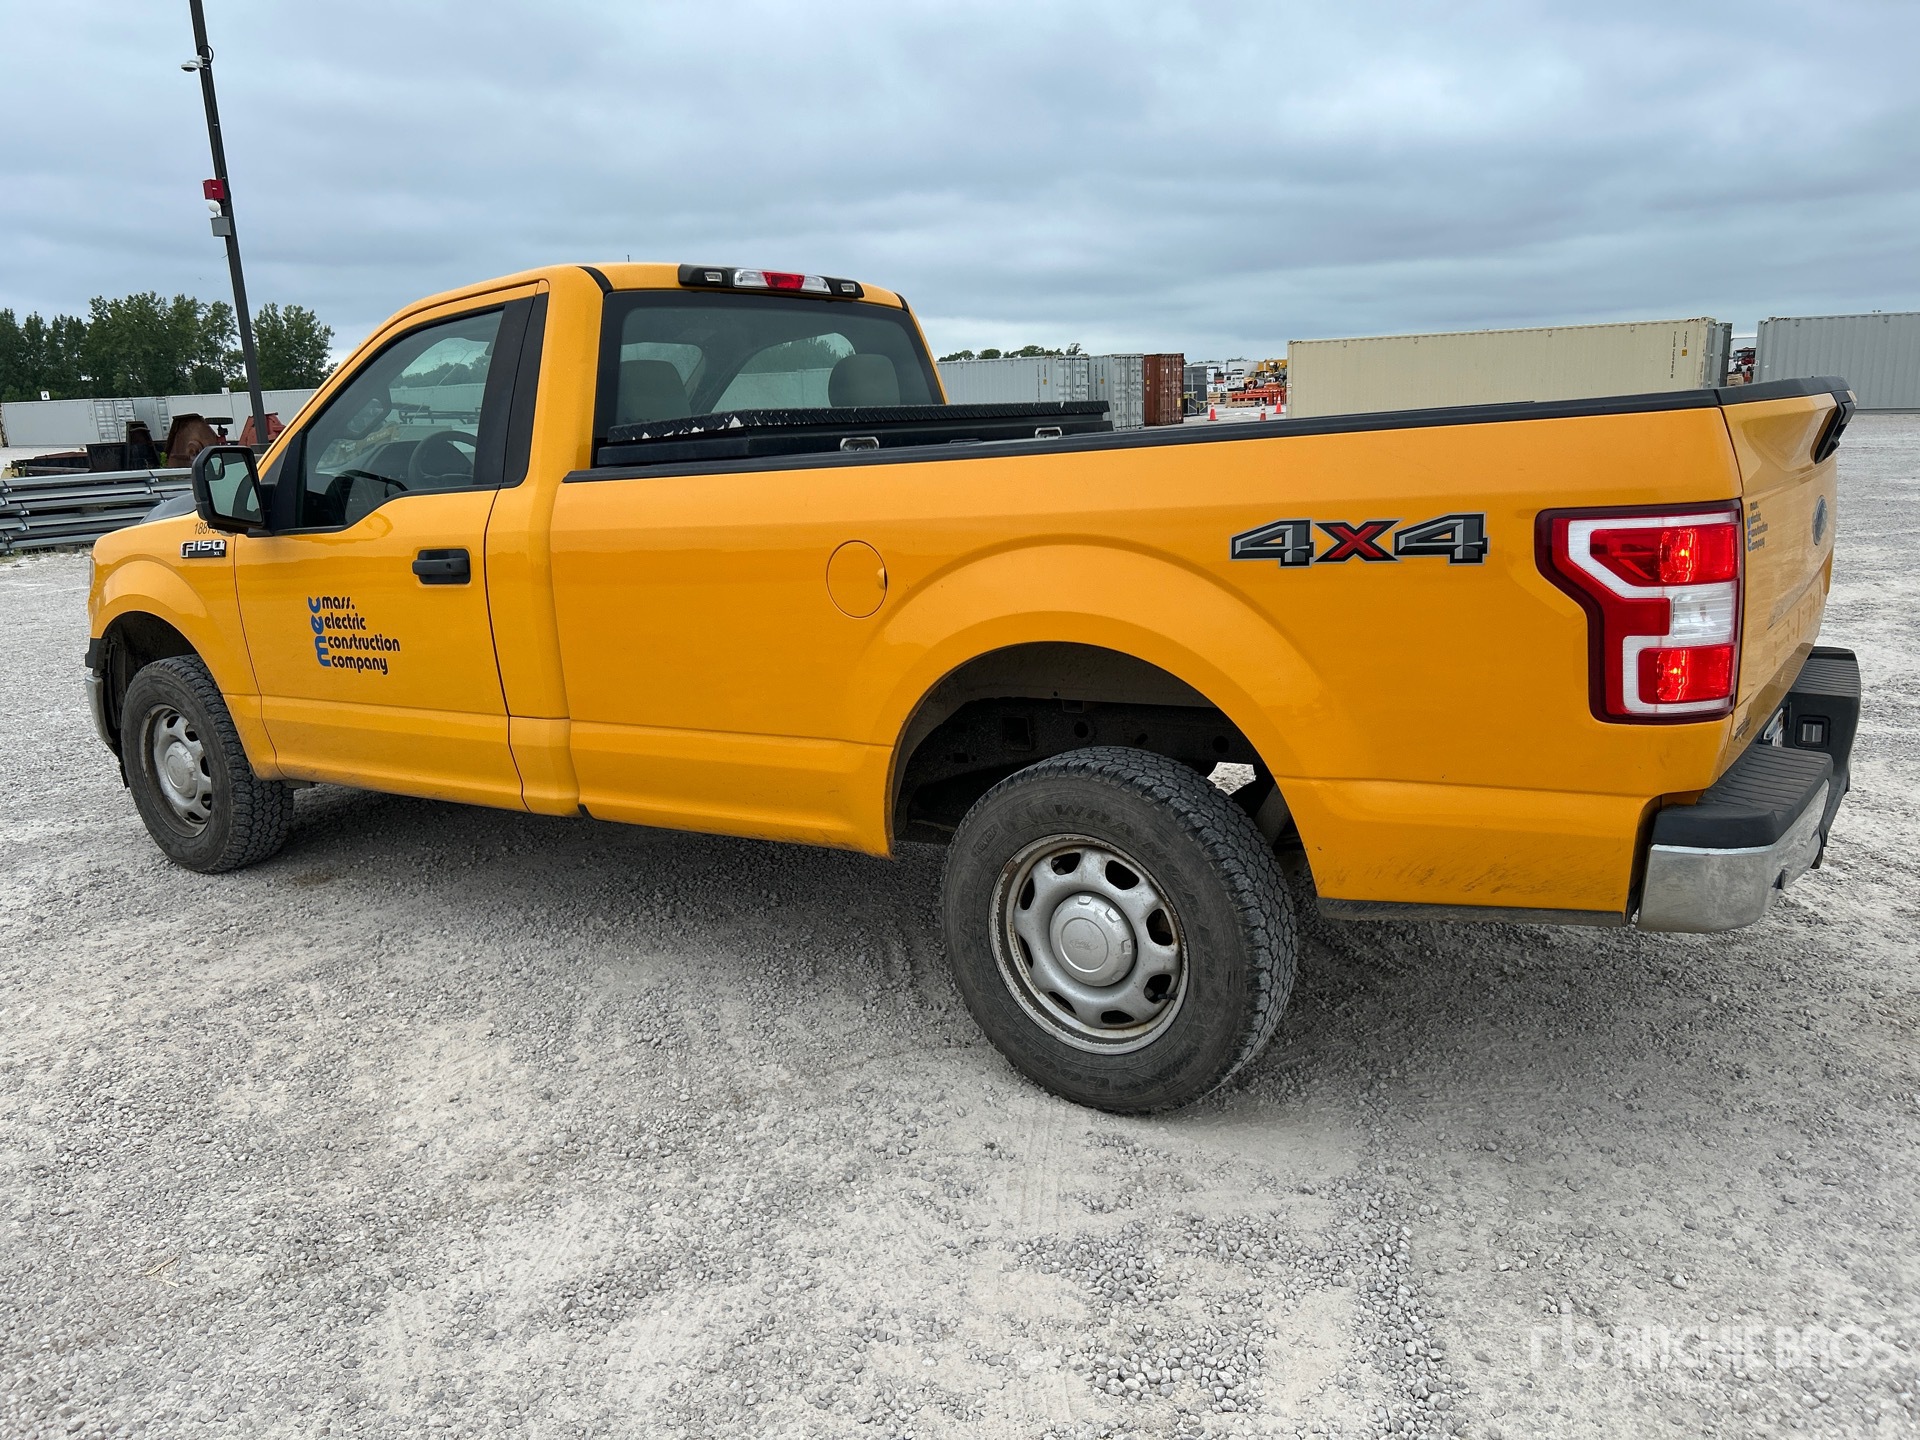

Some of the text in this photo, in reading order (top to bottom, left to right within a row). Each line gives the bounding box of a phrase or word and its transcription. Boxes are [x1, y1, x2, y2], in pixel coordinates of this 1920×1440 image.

[322, 596, 355, 610] mass.
[324, 612, 367, 630] electric
[328, 634, 400, 652] construction
[331, 655, 388, 675] company
